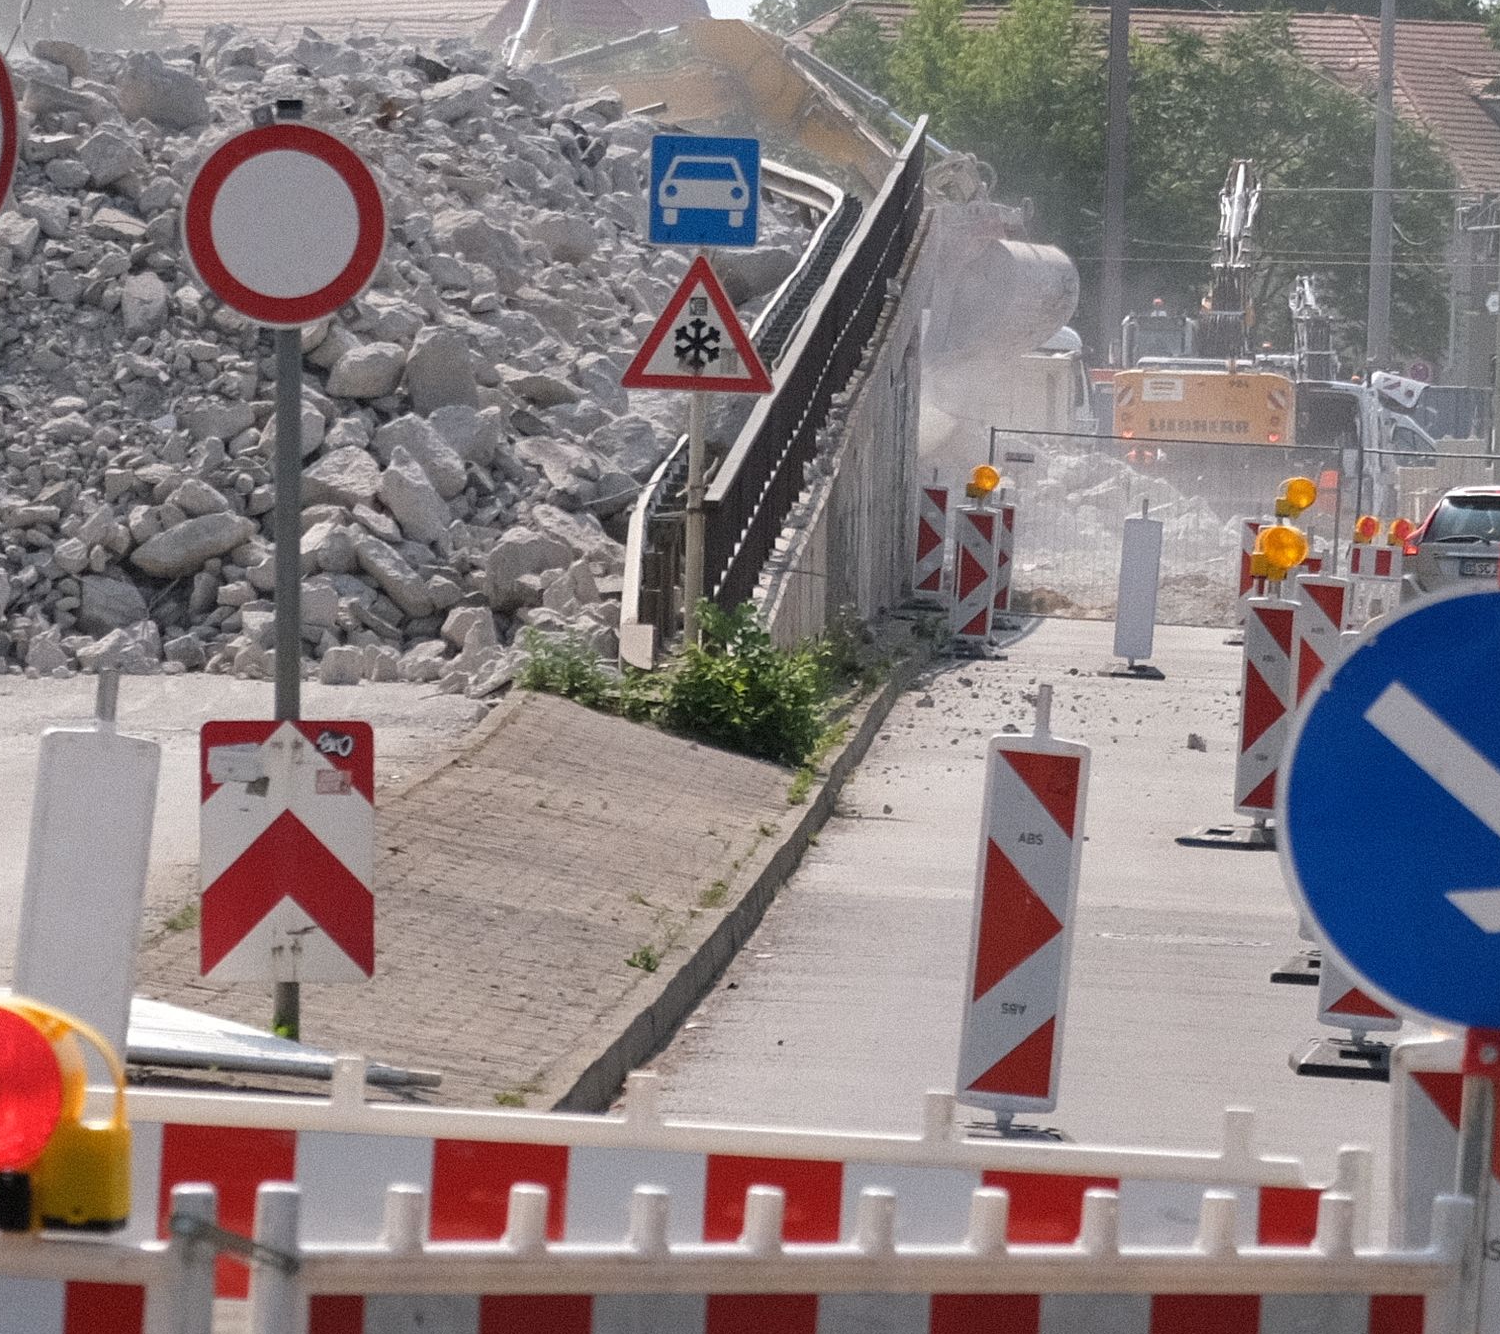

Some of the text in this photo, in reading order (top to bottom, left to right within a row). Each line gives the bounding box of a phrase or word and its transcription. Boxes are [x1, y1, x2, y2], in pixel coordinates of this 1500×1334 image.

[1148, 418, 1250, 434] LIEBHERR
[1017, 831, 1044, 846] ABS
[1001, 1002, 1028, 1015] ABS
